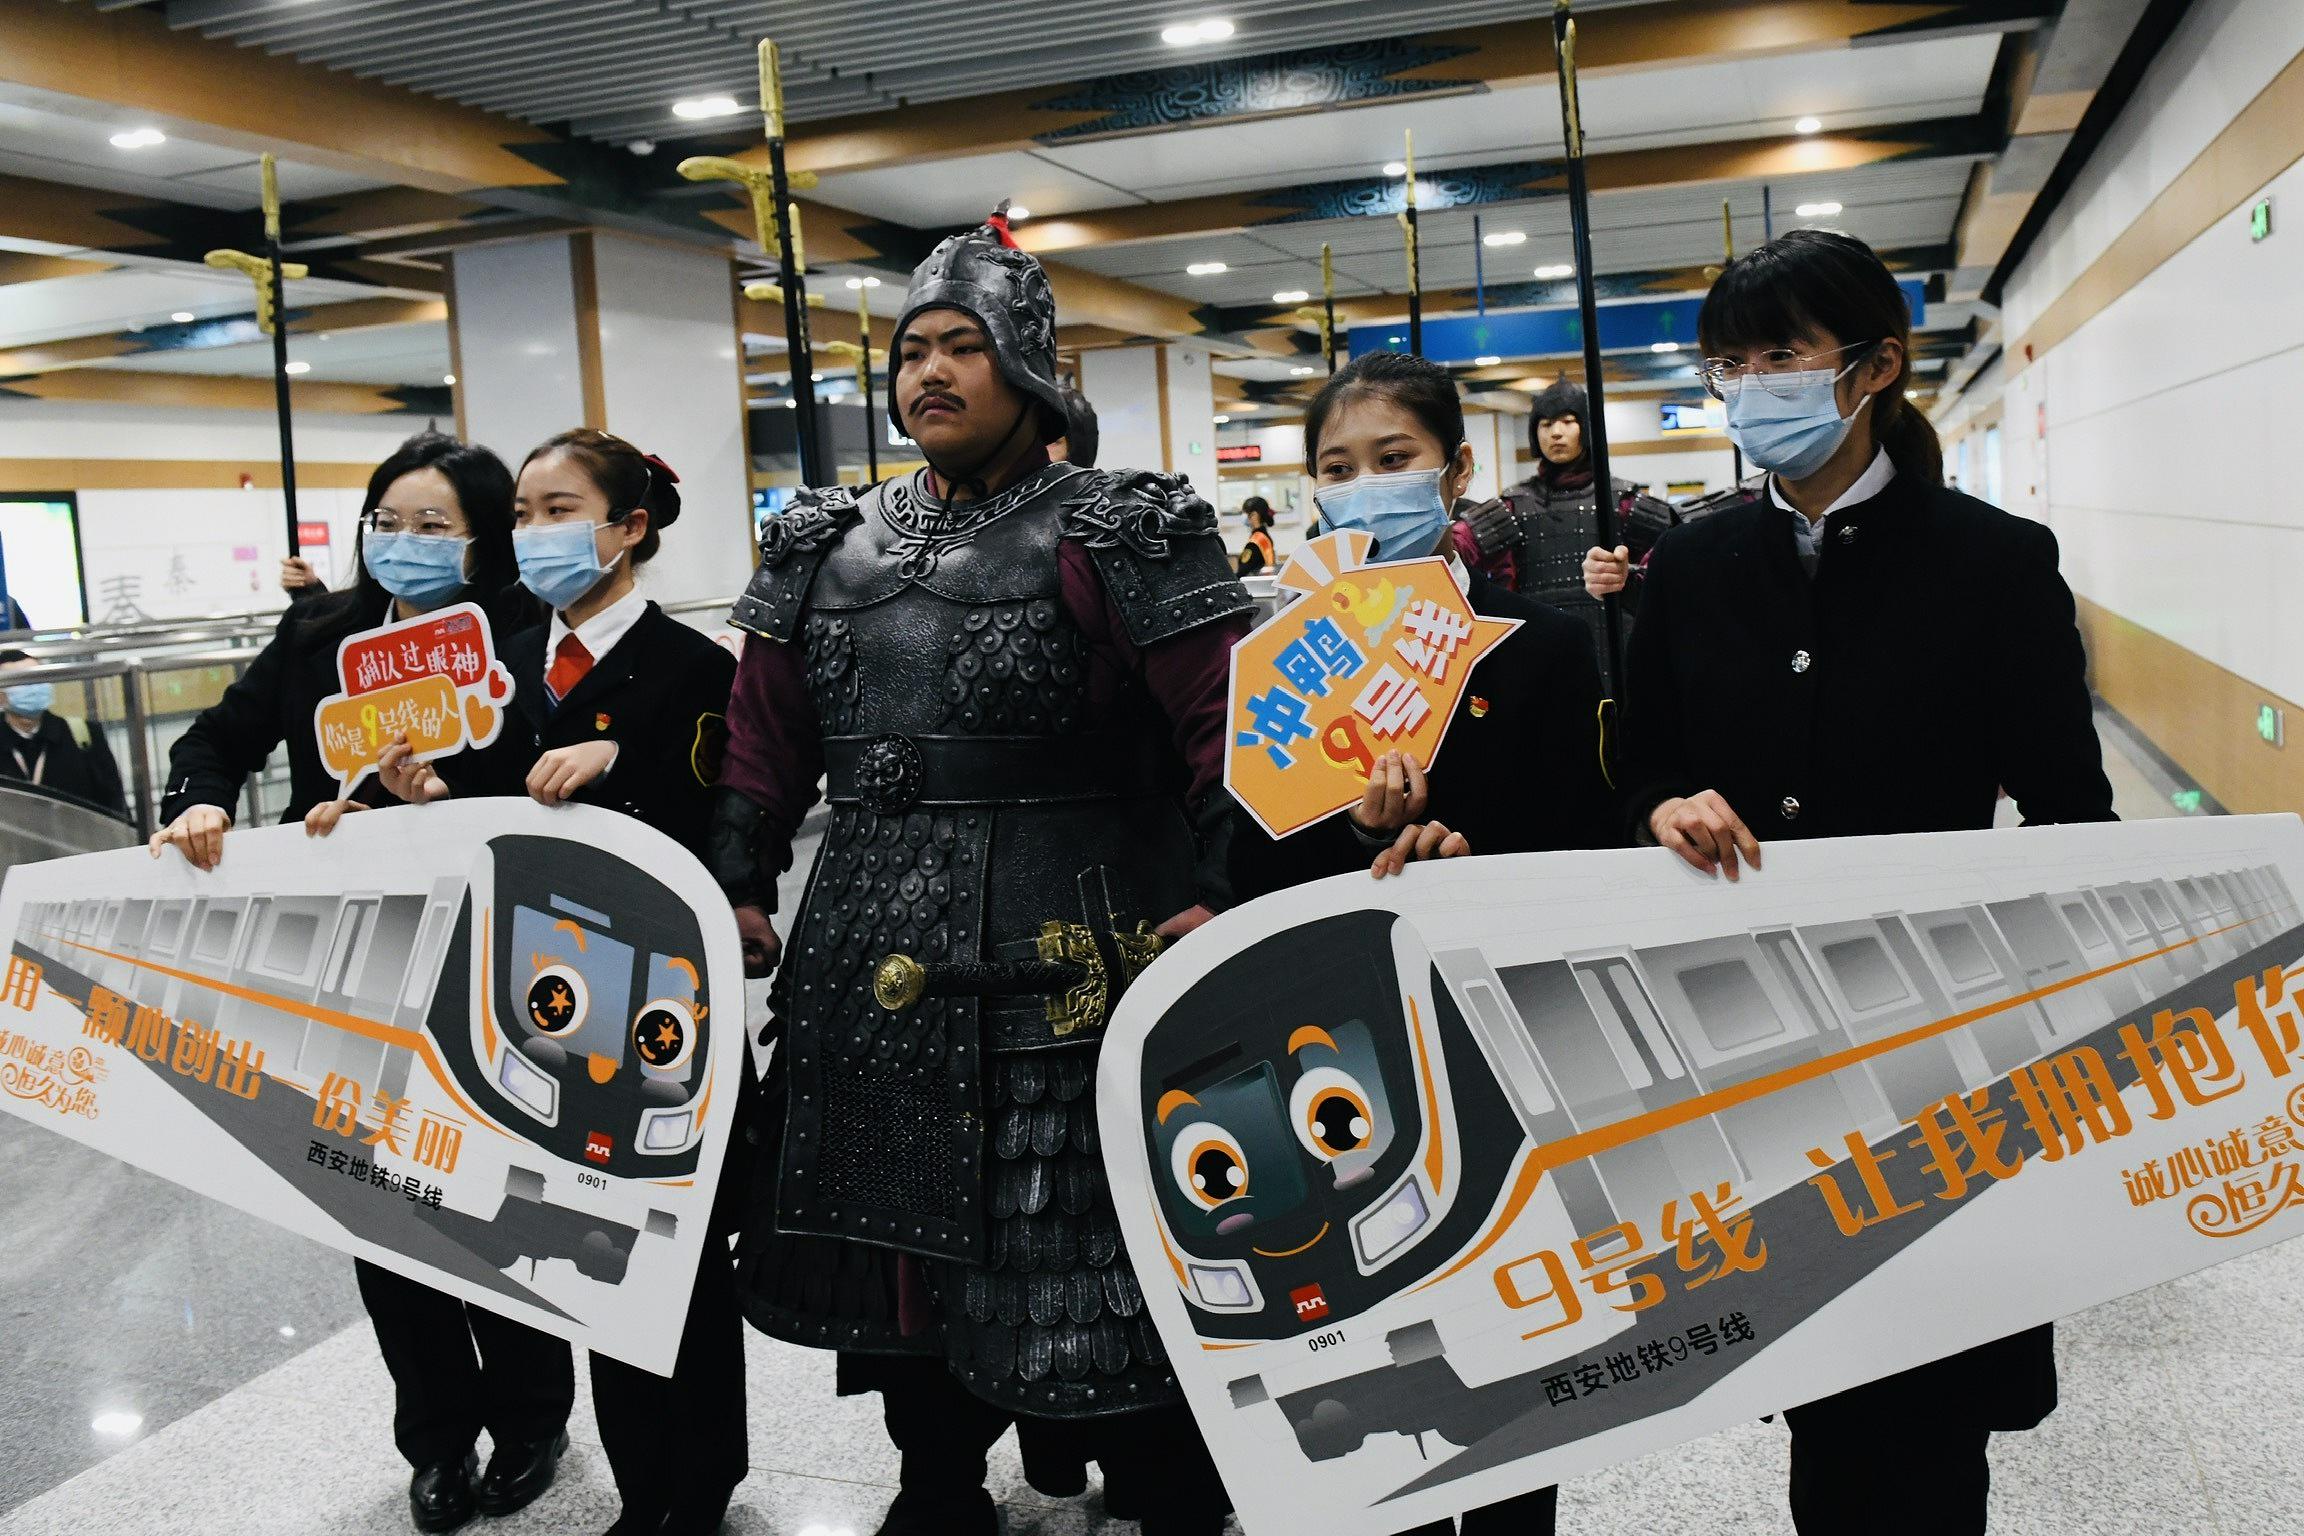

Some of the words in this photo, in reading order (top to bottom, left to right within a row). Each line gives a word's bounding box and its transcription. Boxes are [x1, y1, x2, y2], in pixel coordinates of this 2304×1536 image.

[356, 640, 479, 690] 确认过眼神
[1236, 615, 1370, 772] 冲鸭
[1320, 598, 1474, 786] 9号线
[325, 689, 460, 757] 你是9号线的人
[306, 1140, 444, 1212] 西安地铁9号线
[577, 1172, 608, 1191] 0901
[1493, 1180, 1768, 1341] 9号线
[1804, 964, 2304, 1237] 让我拥抱你
[2120, 1114, 2294, 1208] 诚心诚意
[1308, 1329, 1346, 1352] 0901
[1540, 1311, 1756, 1408] 西安地铁9号线
